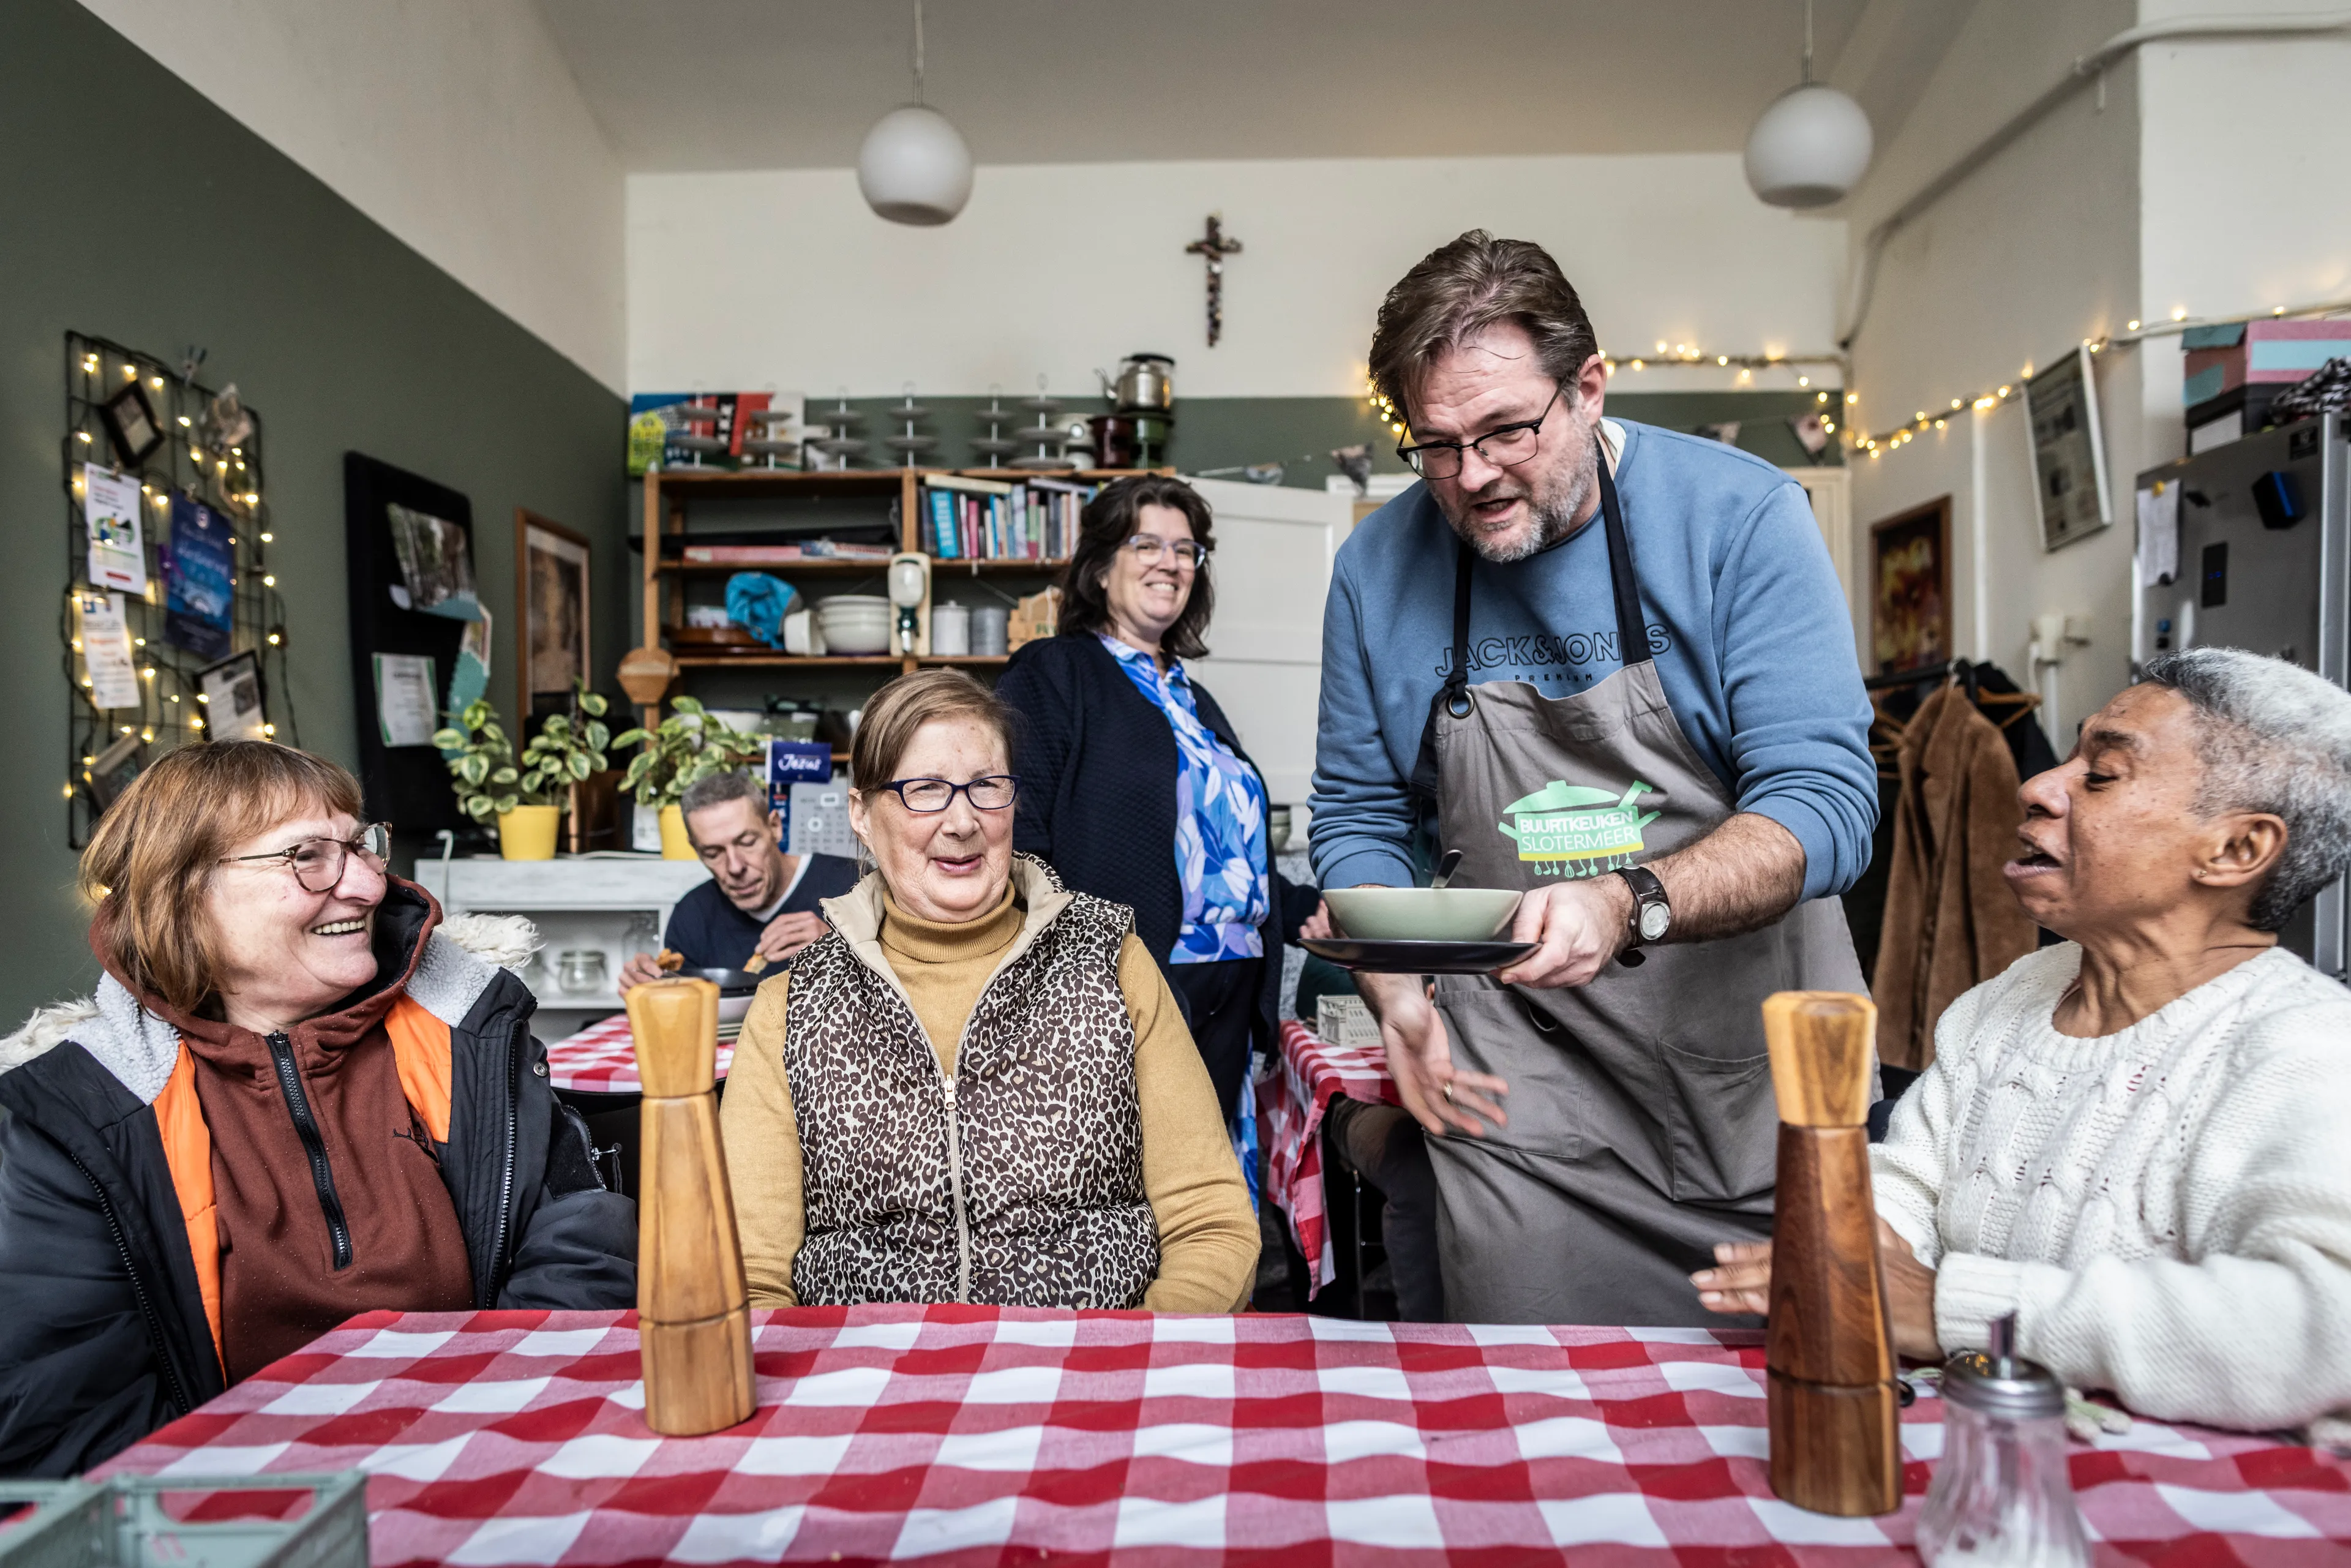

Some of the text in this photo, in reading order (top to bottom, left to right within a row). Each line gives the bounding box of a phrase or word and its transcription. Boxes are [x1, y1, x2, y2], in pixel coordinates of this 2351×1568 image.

[1435, 623, 1672, 678] JACK&JONS
[1515, 673, 1593, 682] PREMIUM
[778, 753, 822, 771] Jezus
[1520, 810, 1633, 834] BUURTKEUKEN
[1521, 826, 1637, 852] SLOTERMEER
